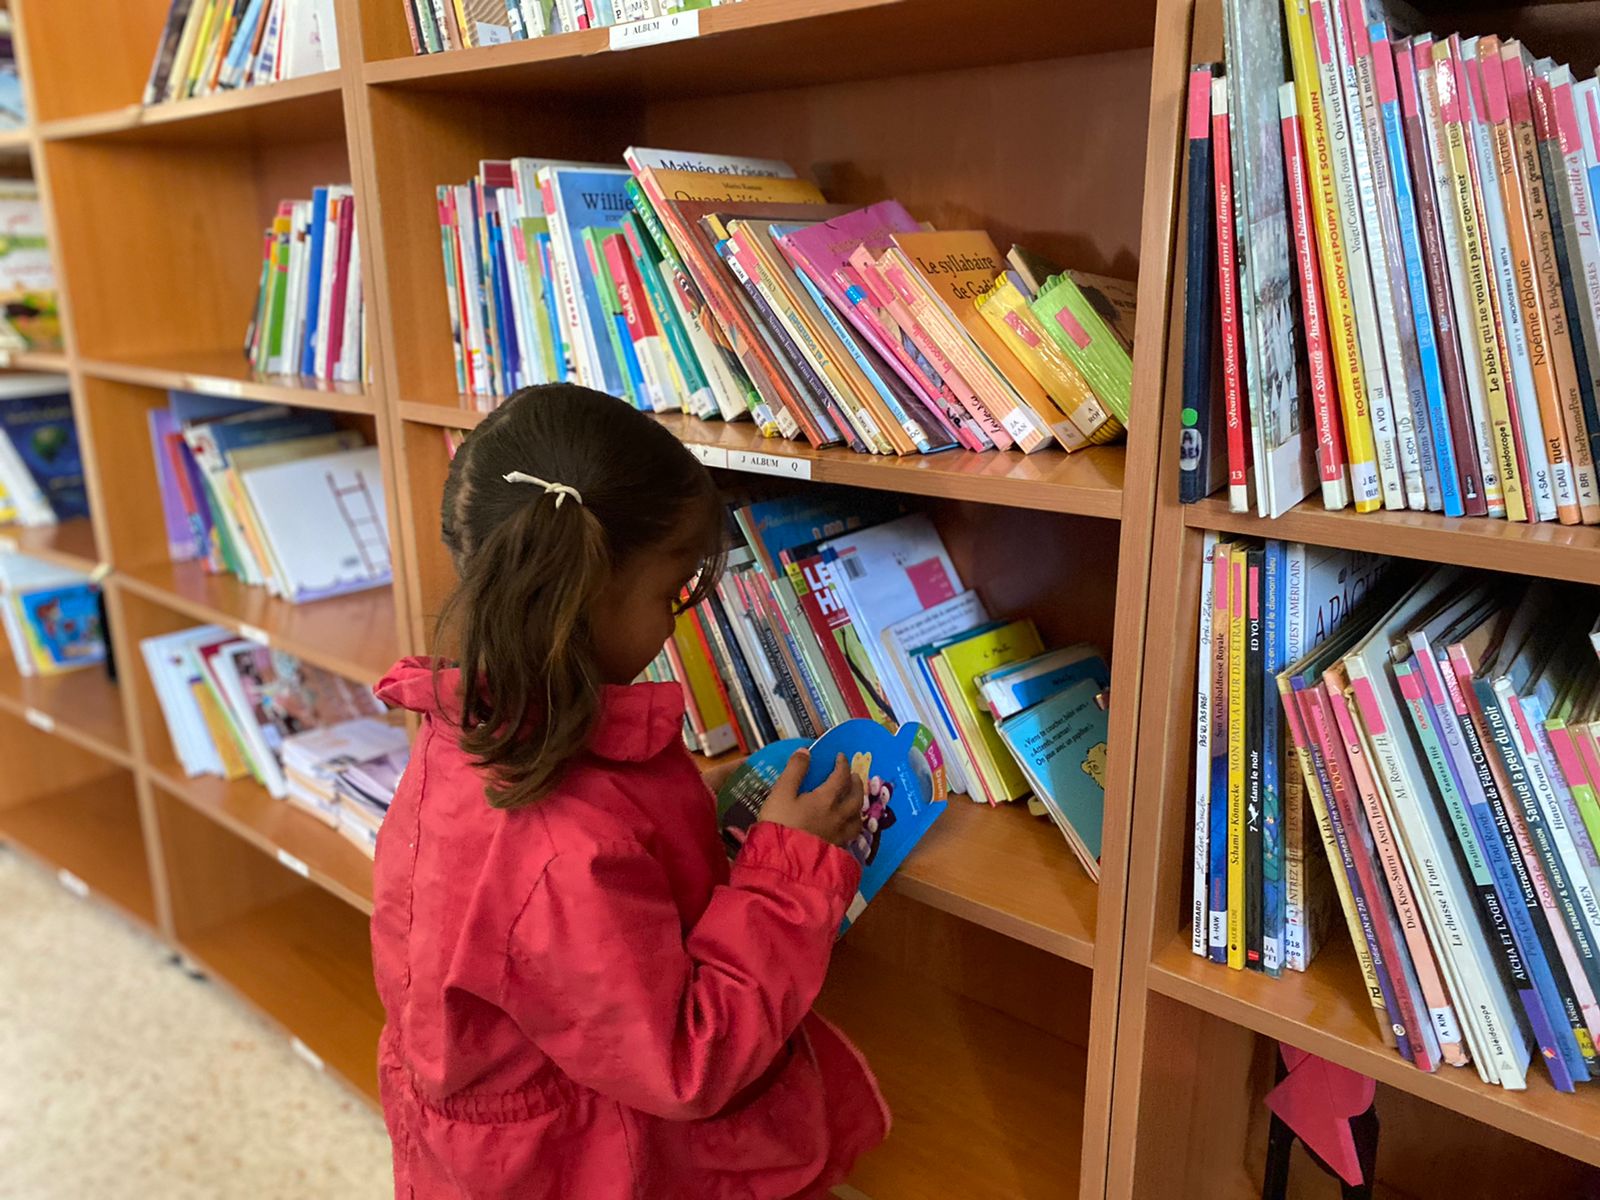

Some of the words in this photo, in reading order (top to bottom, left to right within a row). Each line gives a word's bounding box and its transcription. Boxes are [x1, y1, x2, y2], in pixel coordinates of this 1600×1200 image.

[632, 22, 660, 34] ALBUM
[1329, 74, 1340, 98] bien
[1333, 97, 1342, 118] veut
[1365, 100, 1374, 108] La
[1310, 91, 1329, 170] SOUS-MARIN
[1336, 119, 1346, 141] Qui
[1522, 130, 1532, 146] ou
[1524, 152, 1541, 182] grande
[1323, 174, 1332, 186] LE
[1218, 181, 1230, 222] danger
[1324, 190, 1334, 202] ET
[1457, 174, 1472, 222] coucher
[1532, 186, 1541, 204] suis
[1568, 168, 1588, 220] bouteille
[1534, 208, 1544, 221] Je
[1221, 225, 1228, 240] en
[1326, 208, 1340, 248] POUPY
[1466, 226, 1474, 238] se
[1579, 221, 1592, 238] La
[1221, 241, 1230, 264] ami
[1332, 250, 1344, 264] et
[1468, 240, 1480, 262] pas
[1500, 246, 1510, 265] PLUM
[916, 256, 940, 274] Le
[938, 252, 996, 278] syllabaire
[1504, 266, 1511, 276] ET
[952, 282, 967, 300] de
[1221, 266, 1232, 304] nouvel
[1334, 264, 1348, 300] MOKY
[1472, 264, 1485, 304] voulait
[1518, 260, 1538, 309] éblouie
[1224, 305, 1232, 322] Un
[1479, 308, 1488, 322] ne
[1554, 311, 1565, 336] Park
[1342, 314, 1359, 374] BUSSEMEY
[1480, 325, 1494, 344] qui
[1528, 312, 1546, 367] Noémie
[1224, 332, 1235, 375] Sylvette
[1484, 346, 1498, 376] bébé
[1227, 376, 1234, 387] et
[1490, 378, 1500, 392] Le
[1227, 388, 1238, 428] Sylvain
[1352, 376, 1366, 416] ROGER
[1318, 405, 1333, 445] Sylvain
[1376, 407, 1386, 422] VOI
[1412, 389, 1426, 437] Nord-Sud
[1405, 436, 1418, 464] A-SCH
[1420, 440, 1434, 472] Editions
[750, 457, 779, 468] ALBUM
[792, 461, 798, 472] Q
[1232, 470, 1243, 480] 13
[1326, 464, 1336, 474] 10
[1536, 470, 1550, 500] A-SAC
[1556, 468, 1569, 498] A-DAU
[1580, 472, 1590, 489] BRI
[1582, 490, 1592, 498] A
[1266, 556, 1277, 574] bleu
[1266, 576, 1277, 610] diamant
[1289, 560, 1300, 618] AMÉRICAIN
[1266, 611, 1276, 620] le
[1266, 620, 1276, 629] et
[1216, 632, 1224, 660] Royale
[1250, 636, 1258, 651] ED
[1266, 630, 1278, 674] Arc-en-ciel
[1232, 652, 1242, 676] DES
[1216, 662, 1224, 720] Archibaldtesse
[1232, 678, 1241, 706] PEUR
[1232, 706, 1241, 715] A
[1484, 703, 1503, 728] noir
[1232, 718, 1242, 744] PAPA
[1463, 718, 1484, 764] Clousseau
[1494, 727, 1510, 745] du
[1036, 757, 1046, 766] On
[1232, 746, 1240, 772] MON
[1250, 750, 1259, 770] noir
[1314, 752, 1326, 768] être
[1386, 755, 1403, 783] Rosen
[1501, 742, 1522, 772] peur
[1250, 770, 1258, 780] le
[1320, 766, 1330, 784] pas
[1435, 760, 1452, 793] Vanessa
[1478, 763, 1492, 788] Félix
[1514, 771, 1524, 780] a
[1533, 764, 1548, 791] Oram
[1250, 781, 1258, 802] dans
[1324, 783, 1336, 810] voulait
[1486, 786, 1496, 800] de
[1515, 779, 1541, 822] Samuel
[1230, 784, 1240, 826] Könnecke
[1332, 809, 1340, 820] ne
[1367, 794, 1380, 819] JERAM
[1494, 800, 1510, 831] tableau
[1335, 819, 1346, 834] qui
[1450, 800, 1471, 838] Gay-Para
[1376, 820, 1390, 845] ANITA
[1534, 826, 1551, 852] SIMON
[1231, 832, 1240, 865] Schami
[1338, 833, 1354, 869] L'agneau
[1465, 839, 1482, 869] Praline
[1386, 852, 1409, 906] KING-SMITH
[1424, 858, 1440, 888] l'ours
[1501, 832, 1538, 908] L'extraordinaire
[1543, 851, 1566, 889] CHRISTIAN
[1288, 870, 1298, 907] ENTREZ
[1432, 890, 1444, 898] à
[1533, 864, 1558, 910] Rouge
[1356, 896, 1368, 914] ZAD
[1362, 912, 1370, 922] et
[1438, 898, 1457, 932] chasse
[1482, 891, 1509, 931] L'OGRE
[1561, 896, 1582, 931] RENARDY
[1404, 906, 1416, 930] DICK
[1194, 936, 1200, 948] LE
[1365, 922, 1376, 943] JEAN
[1452, 934, 1464, 947] La
[1499, 930, 1513, 946] ET
[1575, 930, 1593, 959] LISBETH
[1360, 950, 1376, 980] PASTEL
[1370, 942, 1382, 965] Didier
[1436, 1013, 1448, 1028] KIN
[1566, 998, 1580, 1022] loisirs
